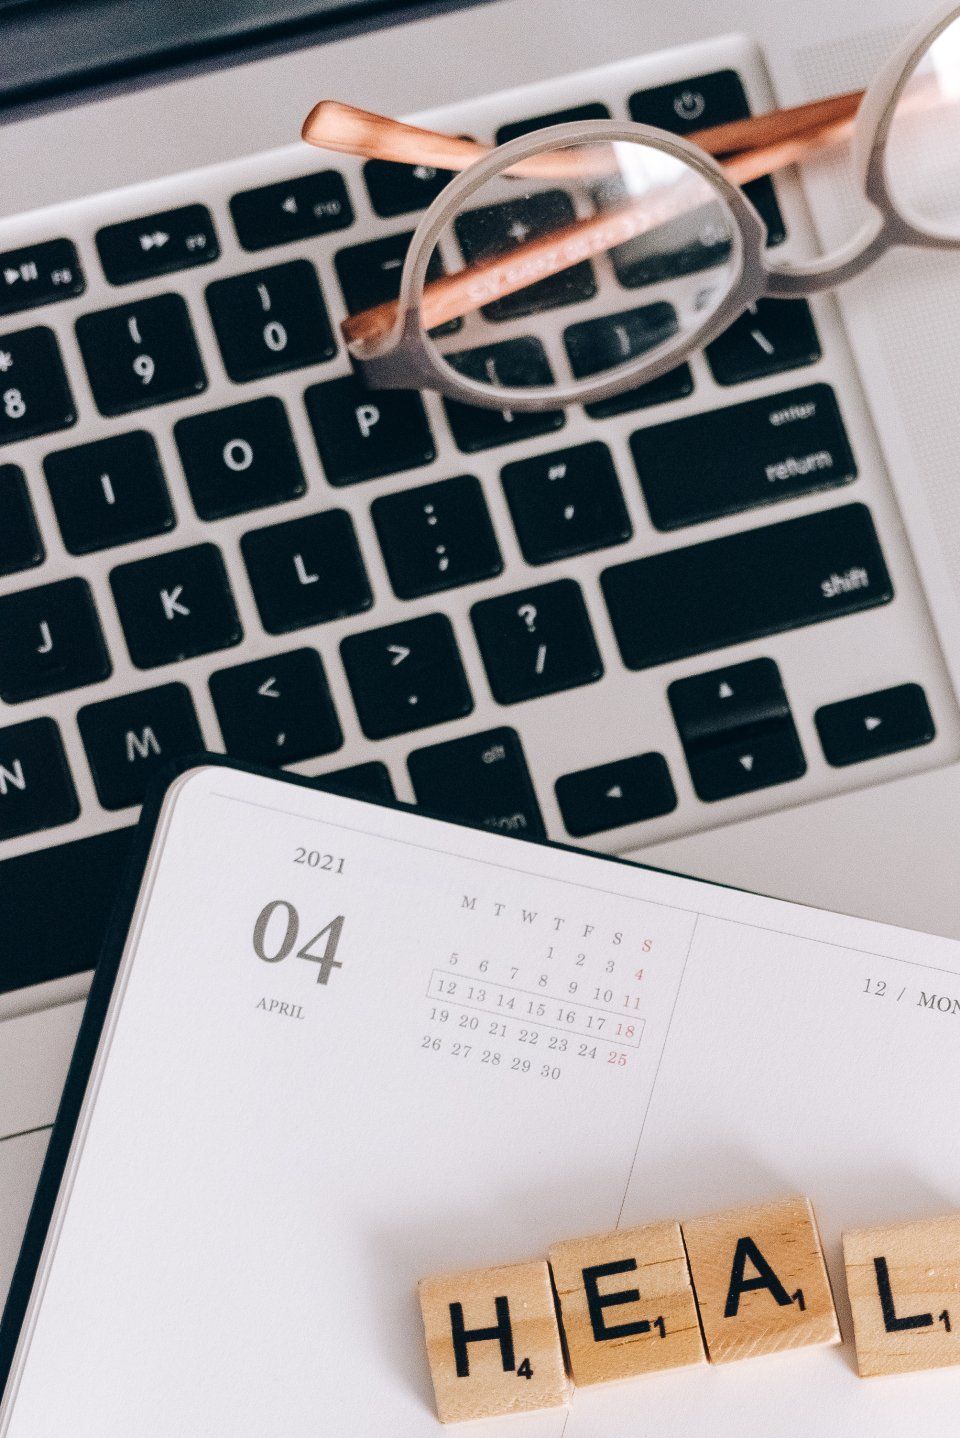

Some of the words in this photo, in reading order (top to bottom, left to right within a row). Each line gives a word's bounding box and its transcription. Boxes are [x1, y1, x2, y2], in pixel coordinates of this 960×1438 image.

[263, 321, 288, 352] 0
[133, 355, 155, 384] 9
[3, 388, 26, 419] 8
[356, 405, 380, 437] P
[223, 439, 254, 471] O
[765, 452, 833, 481] return
[293, 555, 319, 585] L
[821, 569, 869, 598] shift
[160, 586, 190, 619] K
[38, 621, 53, 654] J
[126, 726, 161, 761] M
[0, 760, 26, 795] N
[293, 847, 345, 874] 2021
[461, 895, 477, 910] M
[494, 902, 506, 917] T
[522, 909, 538, 924] W
[553, 917, 565, 931] T
[582, 924, 595, 938] F
[612, 932, 623, 945] S
[641, 939, 653, 952] S
[252, 899, 345, 986] 04
[547, 946, 554, 959] 1
[575, 953, 586, 967] 2
[605, 960, 616, 974] 3
[635, 968, 644, 981] 4
[448, 952, 459, 966] 5
[478, 960, 489, 972] 6
[510, 966, 520, 980] 7
[538, 975, 548, 986] 8
[568, 981, 579, 994] 9
[593, 987, 614, 1003] 10
[623, 994, 641, 1010] 11
[863, 978, 887, 997] 12
[256, 997, 303, 1019] APRIL
[438, 979, 457, 995] 12
[467, 986, 487, 1002] 13
[497, 994, 515, 1010] 14
[527, 1001, 546, 1017] 15
[557, 1008, 575, 1023] 16
[586, 1015, 606, 1031] 17
[616, 1023, 635, 1037] 18
[430, 1007, 450, 1023] 19
[458, 1014, 480, 1030] 20
[488, 1022, 507, 1038] 21
[517, 1029, 539, 1045] 22
[547, 1037, 569, 1052] 23
[577, 1044, 597, 1060] 24
[607, 1051, 627, 1067] 25
[421, 1036, 442, 1051] 26
[450, 1043, 473, 1058] 27
[481, 1051, 501, 1065] 28
[510, 1057, 531, 1073] 29
[540, 1064, 561, 1080] 30
